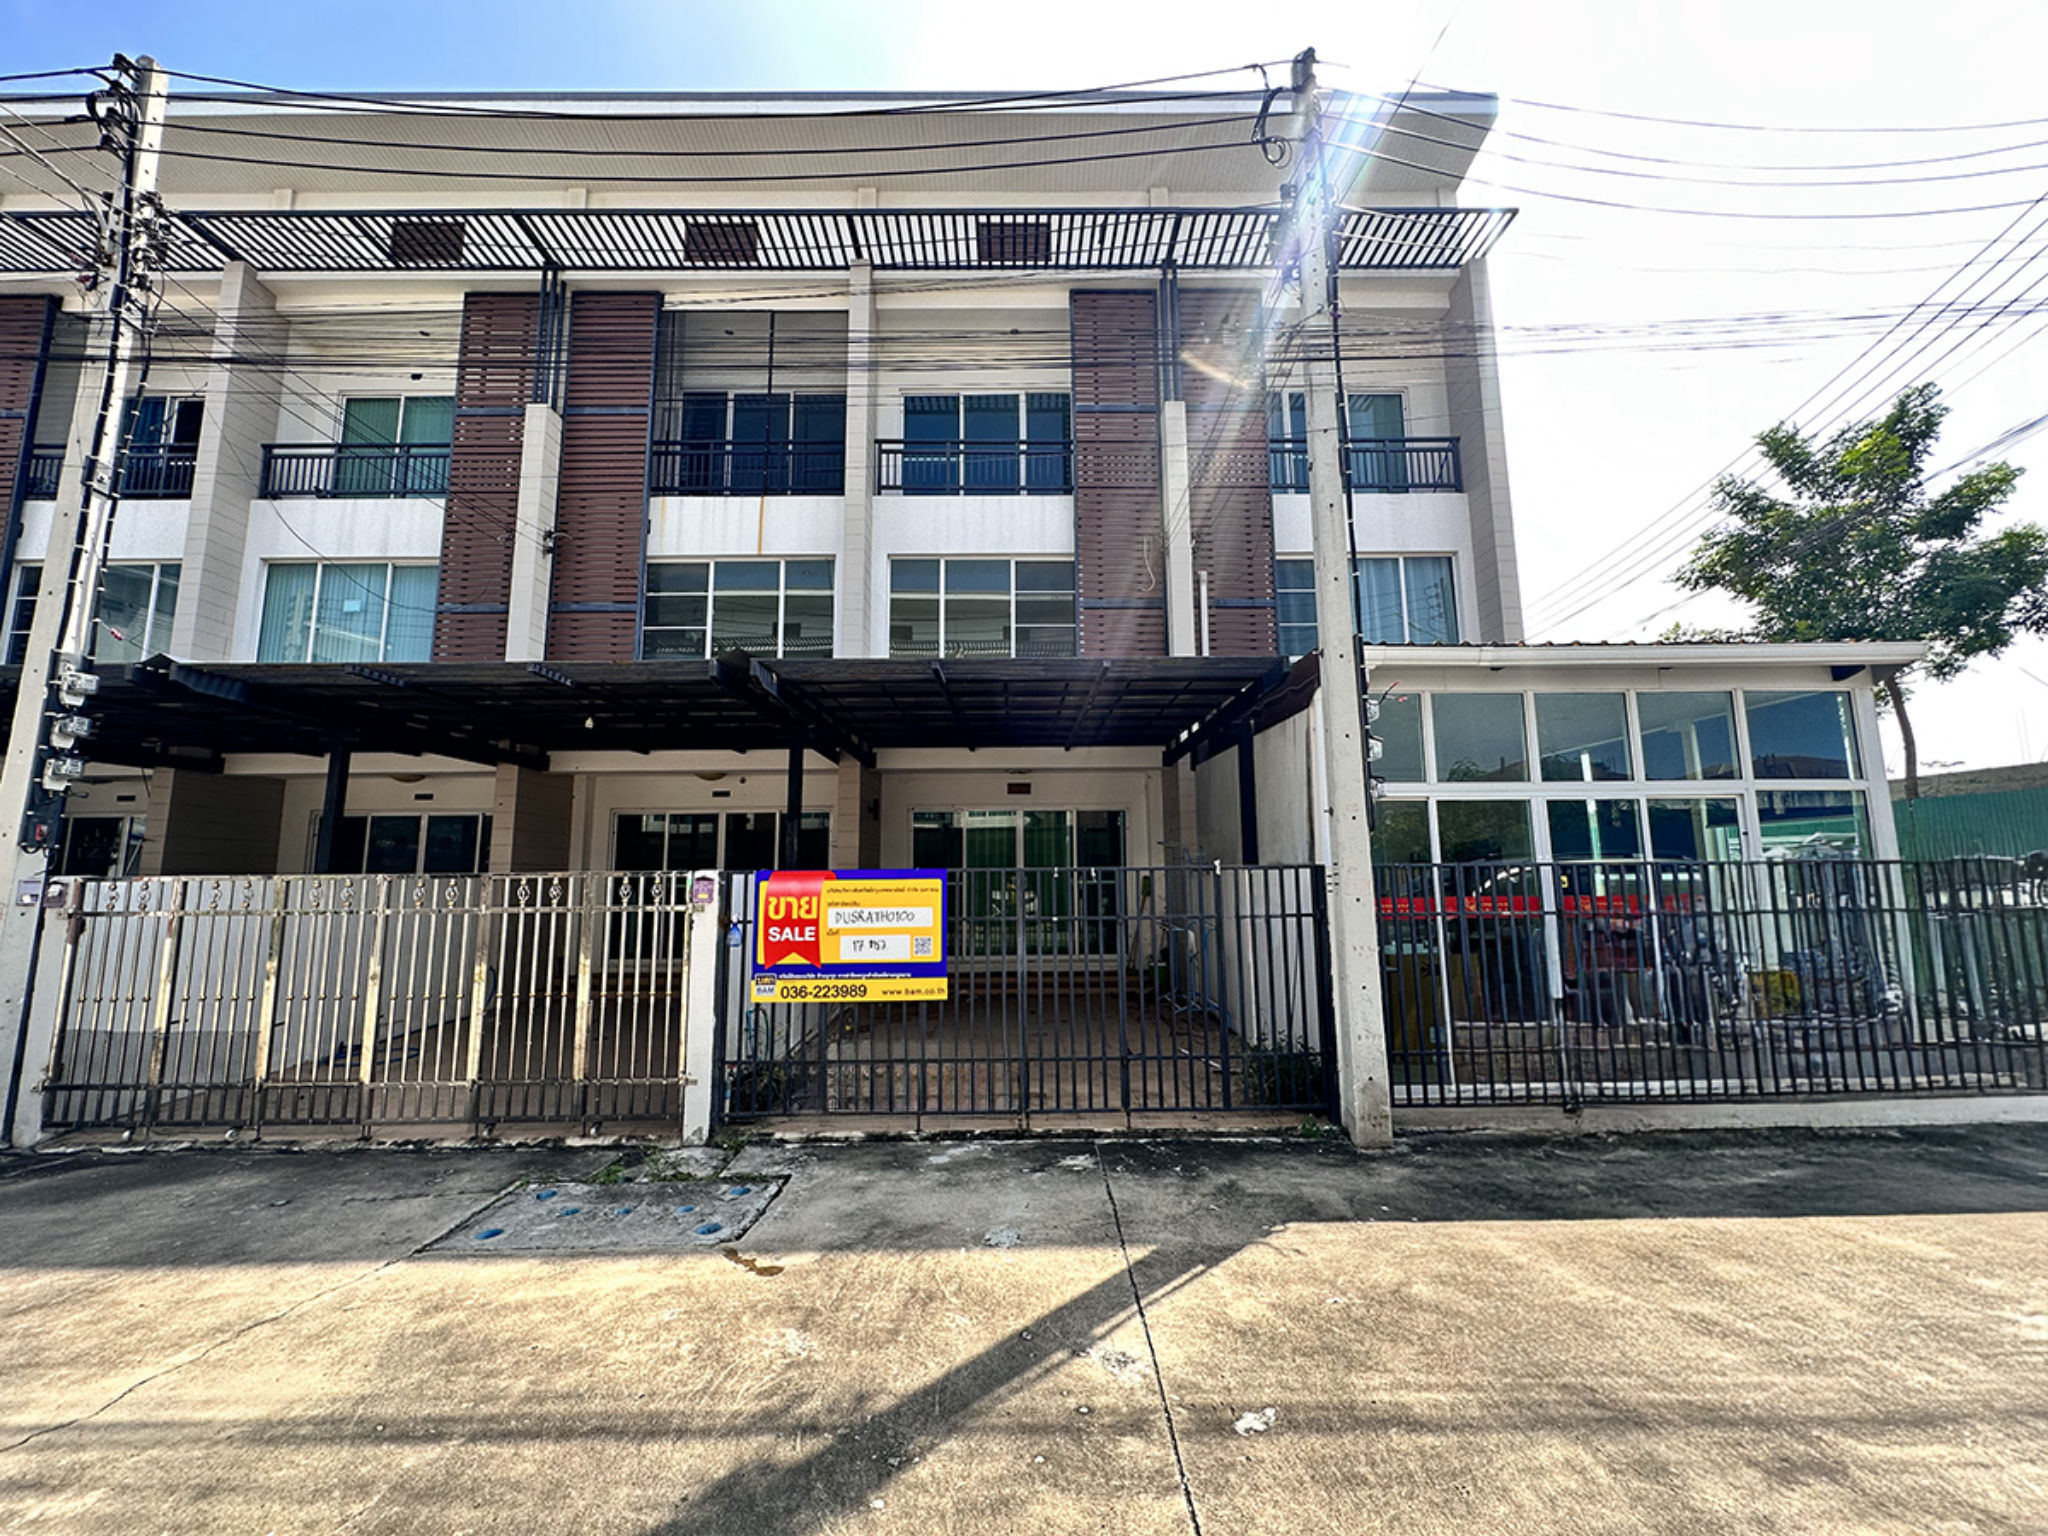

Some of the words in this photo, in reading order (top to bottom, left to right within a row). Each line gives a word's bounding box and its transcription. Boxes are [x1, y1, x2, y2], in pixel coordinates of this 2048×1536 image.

[768, 896, 817, 921] ขาย
[768, 927, 816, 943] SALE
[780, 984, 867, 999] 036-223989
